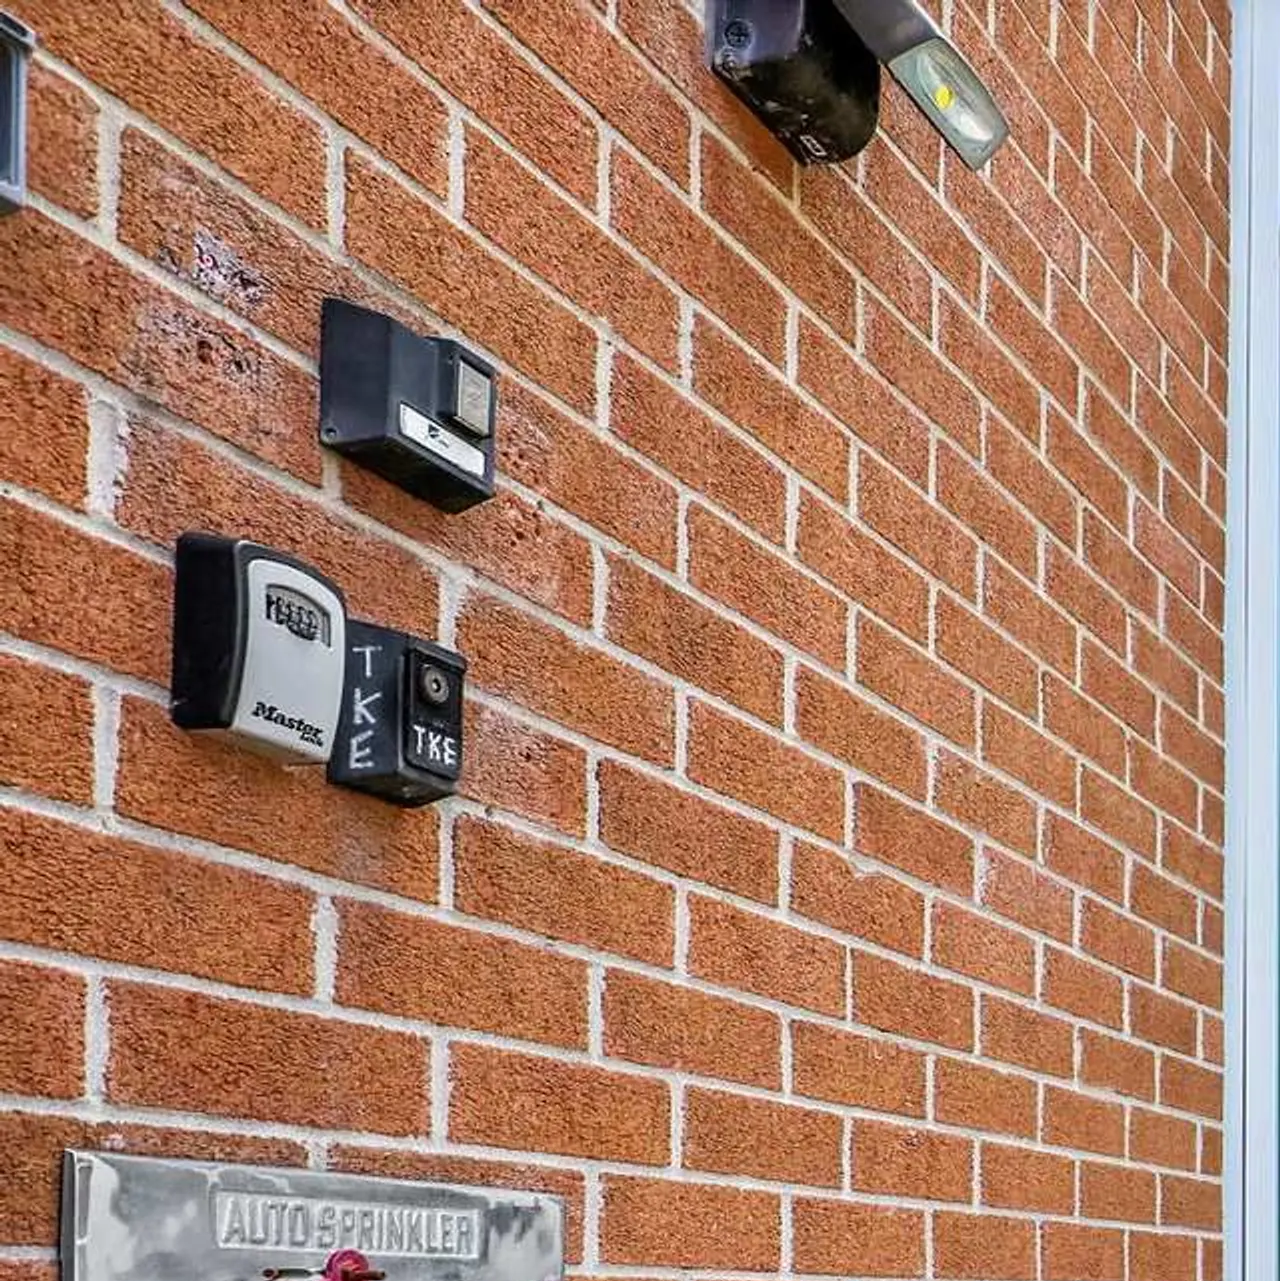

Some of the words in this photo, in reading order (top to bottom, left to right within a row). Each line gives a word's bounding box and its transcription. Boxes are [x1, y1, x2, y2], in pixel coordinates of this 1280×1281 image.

[252, 701, 323, 738] Master
[350, 645, 382, 769] TKE
[413, 725, 457, 765] TKE
[222, 1200, 308, 1245] AUTO
[317, 1206, 476, 1254] SPRINKLER
